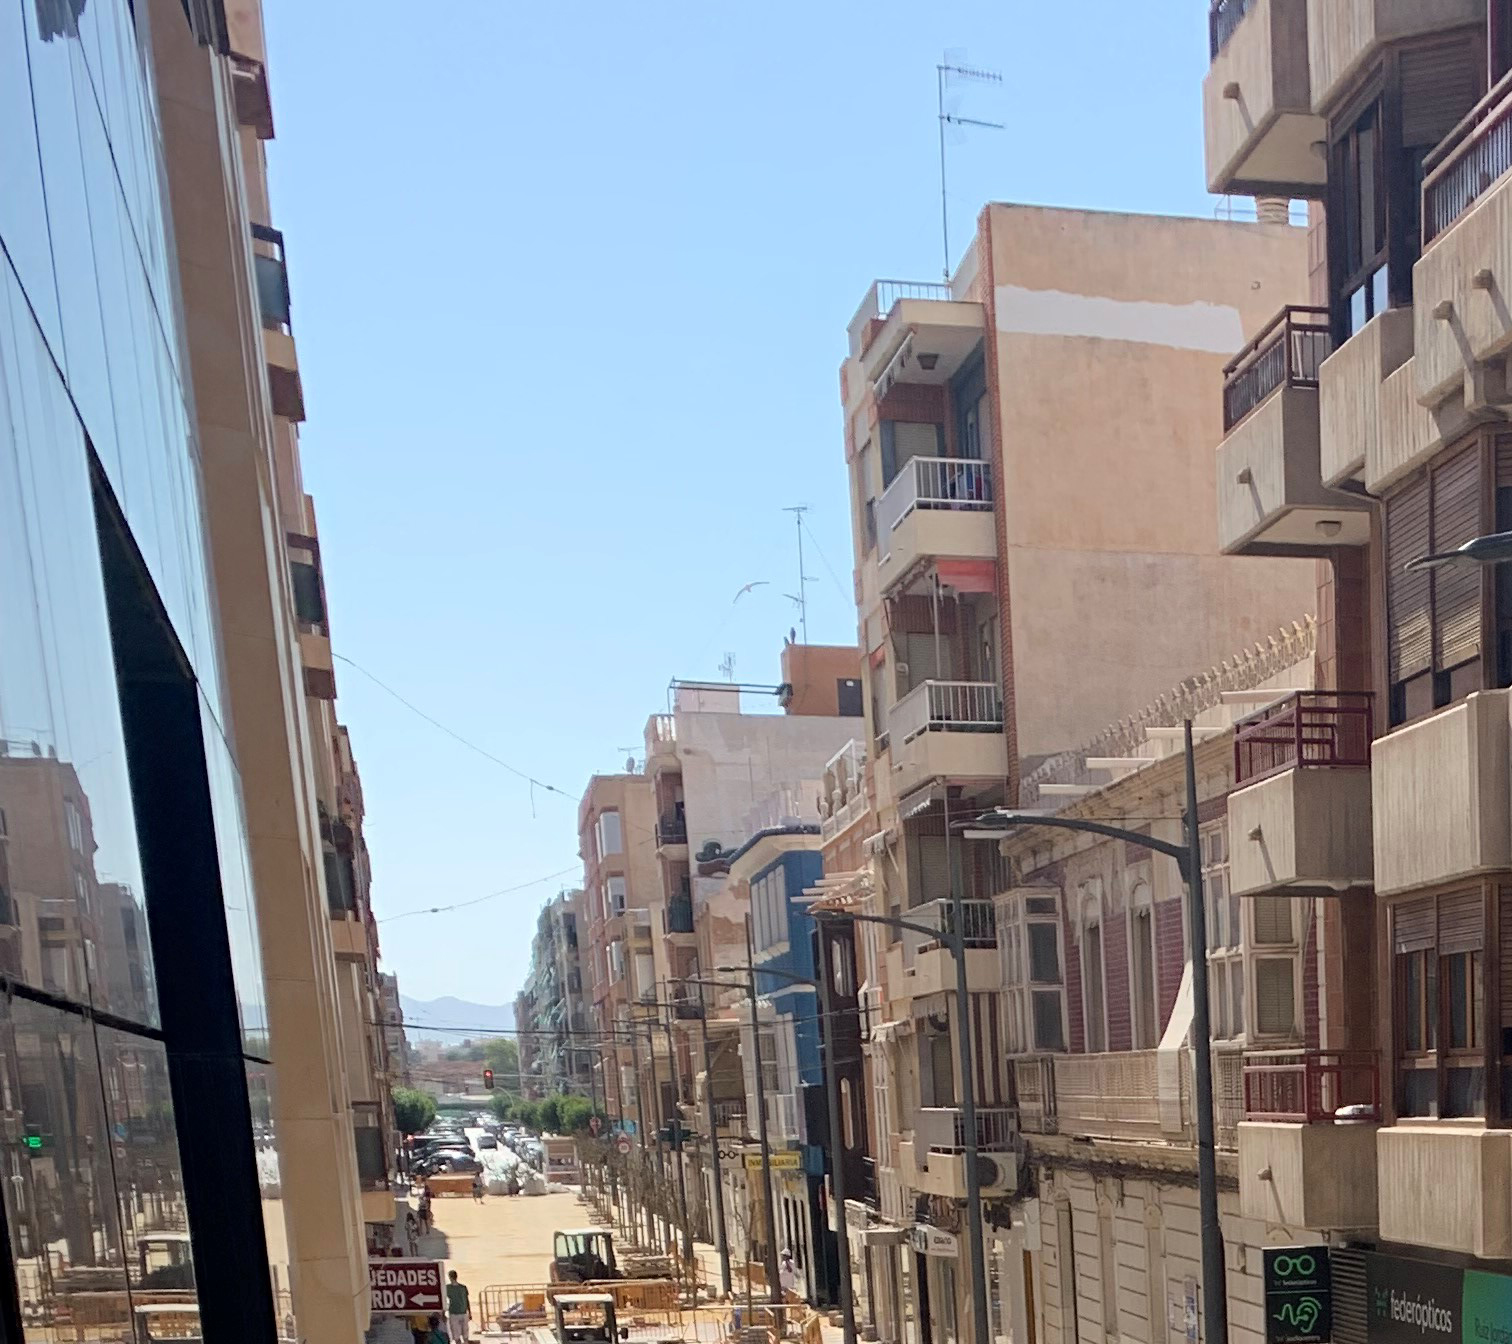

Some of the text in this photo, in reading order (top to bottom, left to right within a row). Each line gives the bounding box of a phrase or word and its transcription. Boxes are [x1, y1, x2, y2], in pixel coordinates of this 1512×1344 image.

[369, 1266, 437, 1286] ÜEDADES
[372, 1289, 405, 1308] RDO
[1390, 1289, 1452, 1333] federópticos
[1475, 1318, 1488, 1340] Ruiz
